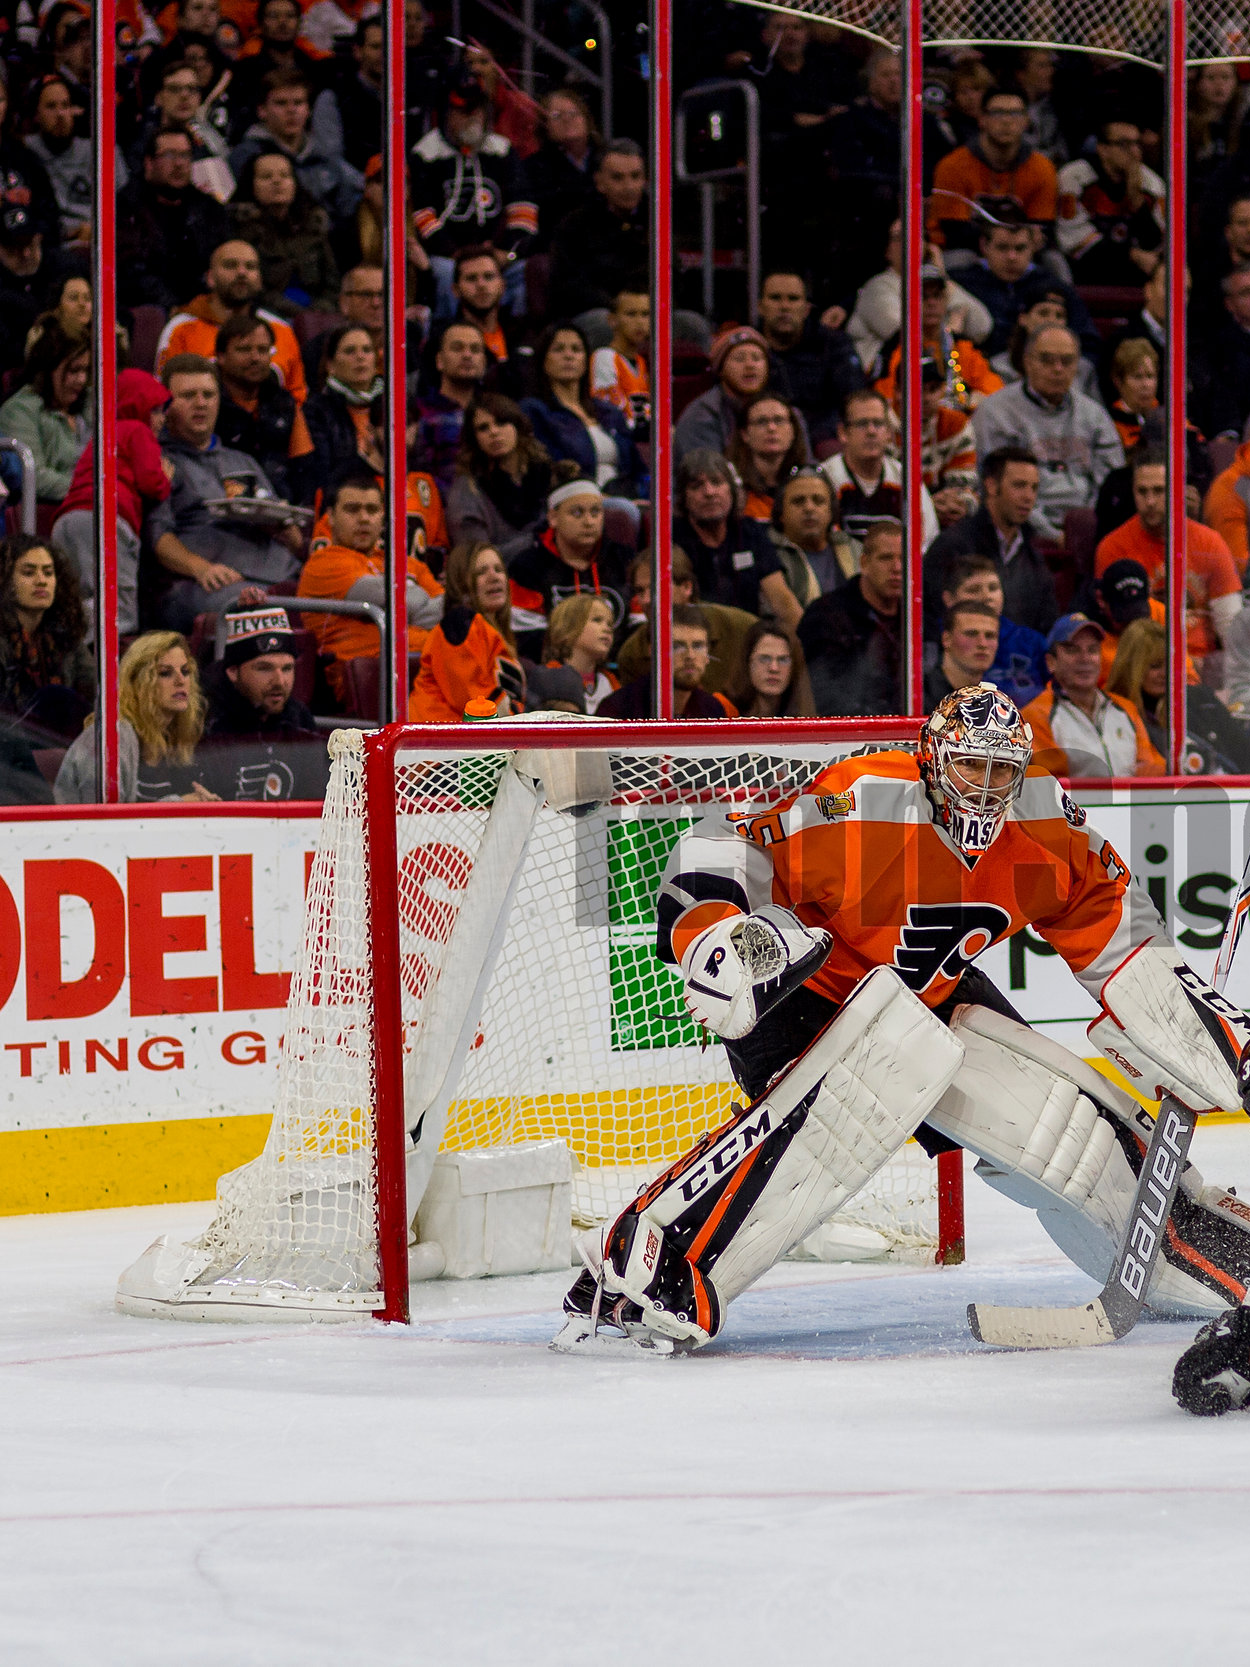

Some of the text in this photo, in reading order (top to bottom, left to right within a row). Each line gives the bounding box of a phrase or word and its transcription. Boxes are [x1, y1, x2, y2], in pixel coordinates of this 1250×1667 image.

[233, 614, 287, 634] FLYERS
[677, 1109, 773, 1202] CCM
[1118, 1109, 1190, 1301] BAUER
